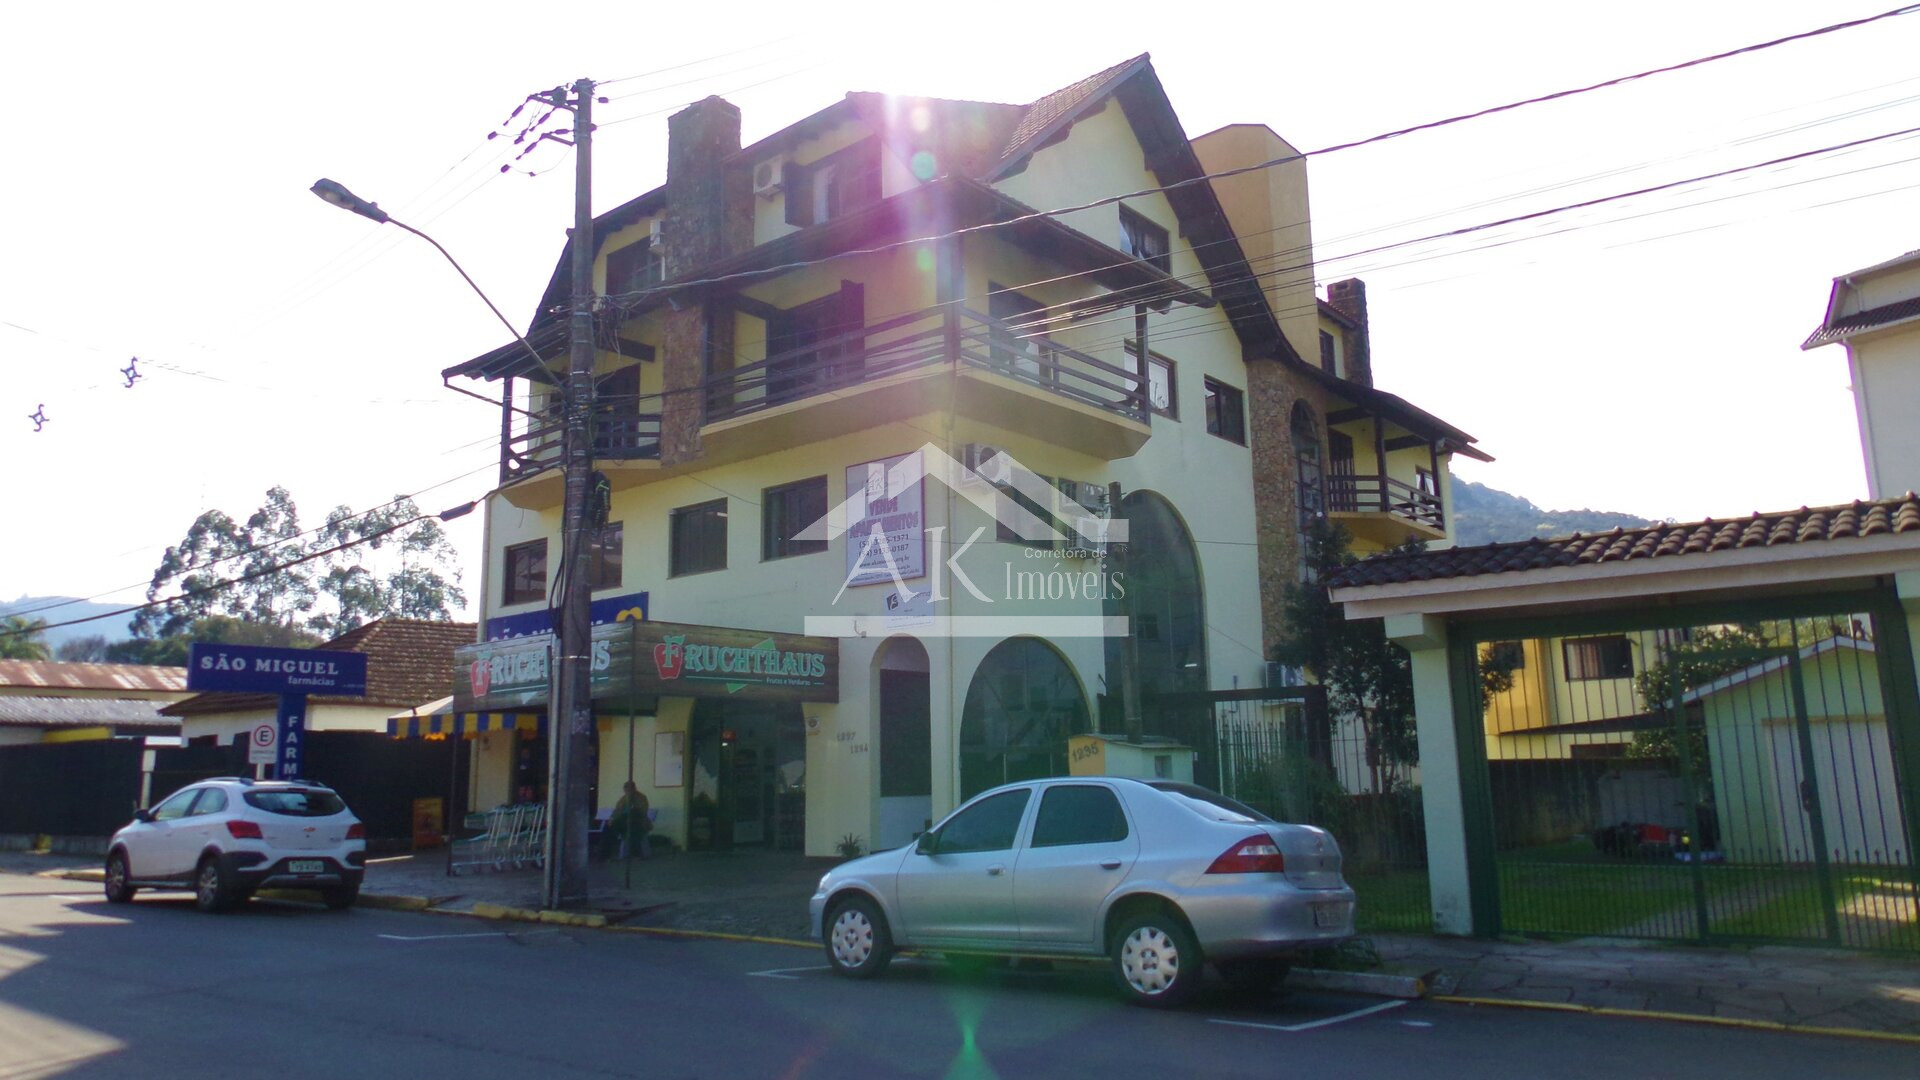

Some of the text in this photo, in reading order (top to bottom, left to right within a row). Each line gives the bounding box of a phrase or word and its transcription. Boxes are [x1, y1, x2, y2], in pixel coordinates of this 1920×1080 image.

[201, 653, 339, 675] SÃO MIGUEL
[663, 634, 826, 677] FRUCHTHAUS
[288, 676, 335, 686] farmácias
[260, 731, 269, 742] E
[284, 716, 298, 780] FARM
